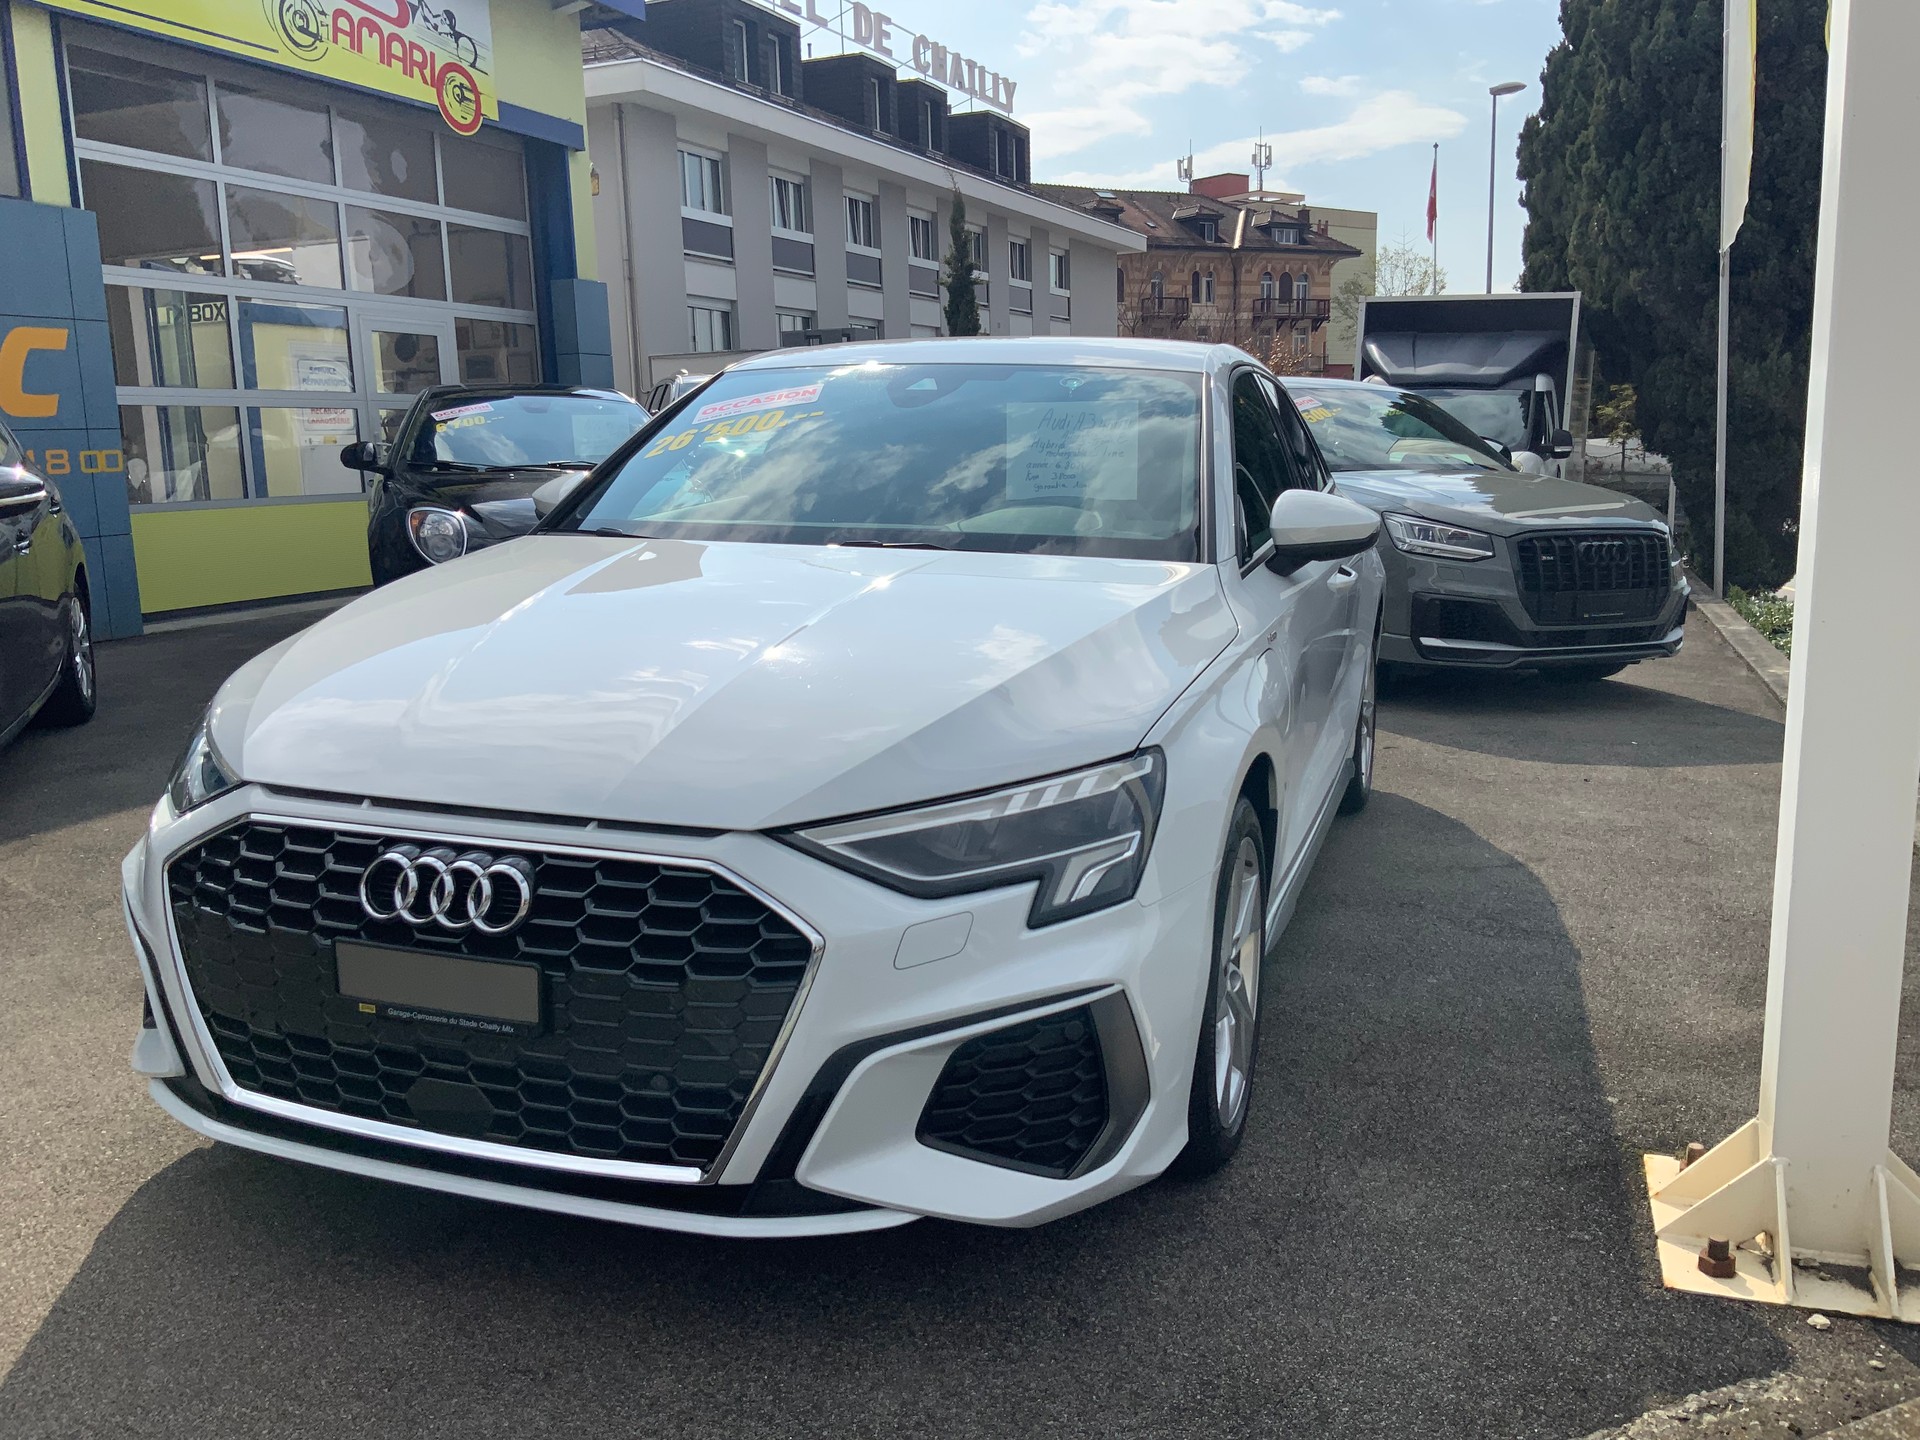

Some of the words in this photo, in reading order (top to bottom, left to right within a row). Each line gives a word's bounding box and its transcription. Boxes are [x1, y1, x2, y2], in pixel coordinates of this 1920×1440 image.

[853, 2, 893, 57] DE
[912, 34, 1017, 114] CHAILLY
[189, 303, 226, 322] BOX
[435, 404, 491, 418] OCCASION
[702, 388, 818, 416] OCCASION
[1037, 408, 1071, 431] Audi
[387, 1007, 448, 1023] Garage-Carrosserie
[449, 1016, 458, 1025] du
[459, 1018, 478, 1028] Stade
